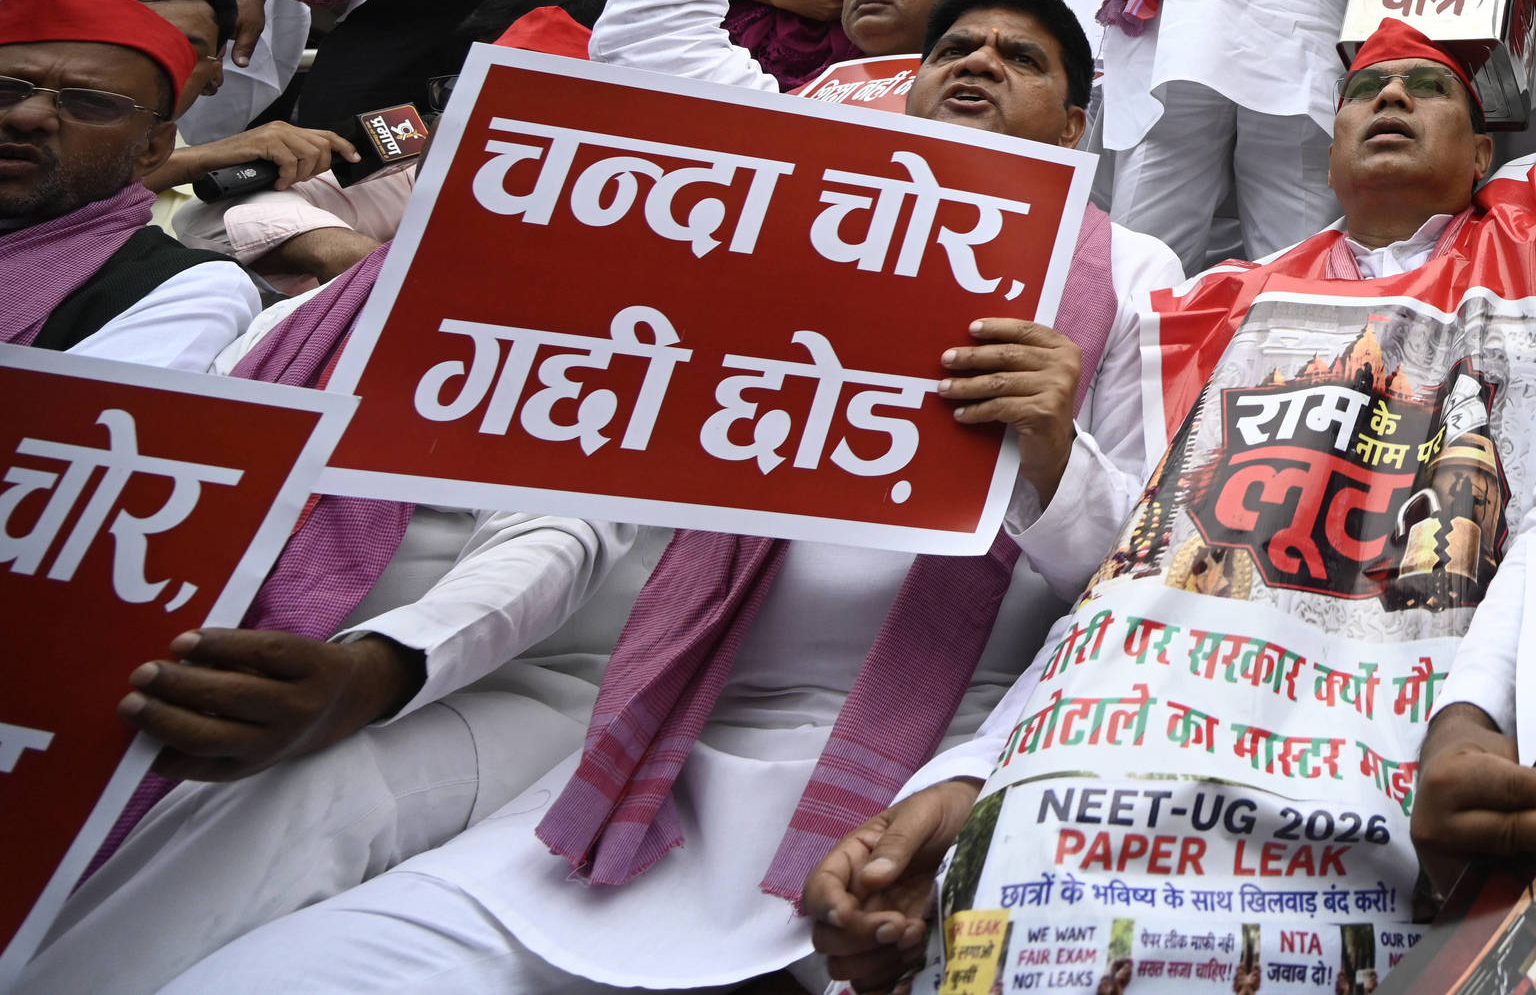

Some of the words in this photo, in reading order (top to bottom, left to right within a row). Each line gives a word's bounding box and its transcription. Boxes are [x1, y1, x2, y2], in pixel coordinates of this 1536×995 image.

[471, 116, 796, 259] चन्दा
[809, 150, 1032, 303] चोर,
[699, 330, 943, 505] छोड़
[1235, 385, 1371, 452] राम
[1369, 399, 1402, 436] के
[1356, 433, 1410, 469] नाम
[1417, 426, 1447, 464] पर
[1214, 445, 1416, 580] लूट
[1123, 615, 1180, 666] पर
[1187, 628, 1306, 702] सरकार
[1313, 661, 1381, 721] क्यों
[1391, 657, 1449, 723] मौ
[1166, 701, 1219, 753] का
[1230, 722, 1346, 781] मास्टर
[1036, 788, 1257, 835] NEET-UG
[1274, 807, 1391, 846] 2026
[1054, 828, 1205, 876] PAPER
[1233, 839, 1352, 877] LEAK
[1000, 873, 1056, 909] छात्रों
[1061, 873, 1085, 904] के
[1092, 879, 1157, 910] भविष्य
[1164, 881, 1184, 910] के
[1191, 890, 1232, 913] साथ
[1241, 883, 1318, 919] खिलवाड़
[1322, 885, 1349, 915] बंद
[1354, 881, 1397, 915] करो!
[1017, 948, 1050, 966] FAIR
[1055, 947, 1097, 964] EXAM
[1028, 928, 1050, 943] WE
[1055, 926, 1096, 942] WANT
[1140, 930, 1161, 948] पेपर
[1163, 931, 1187, 950] लीक
[1280, 931, 1322, 955] NTA
[1380, 932, 1405, 948] OUR
[1012, 973, 1046, 990] NOT
[1049, 971, 1094, 988] LEAKS
[1267, 962, 1307, 985] जवाब
[1311, 959, 1333, 986] दो!
